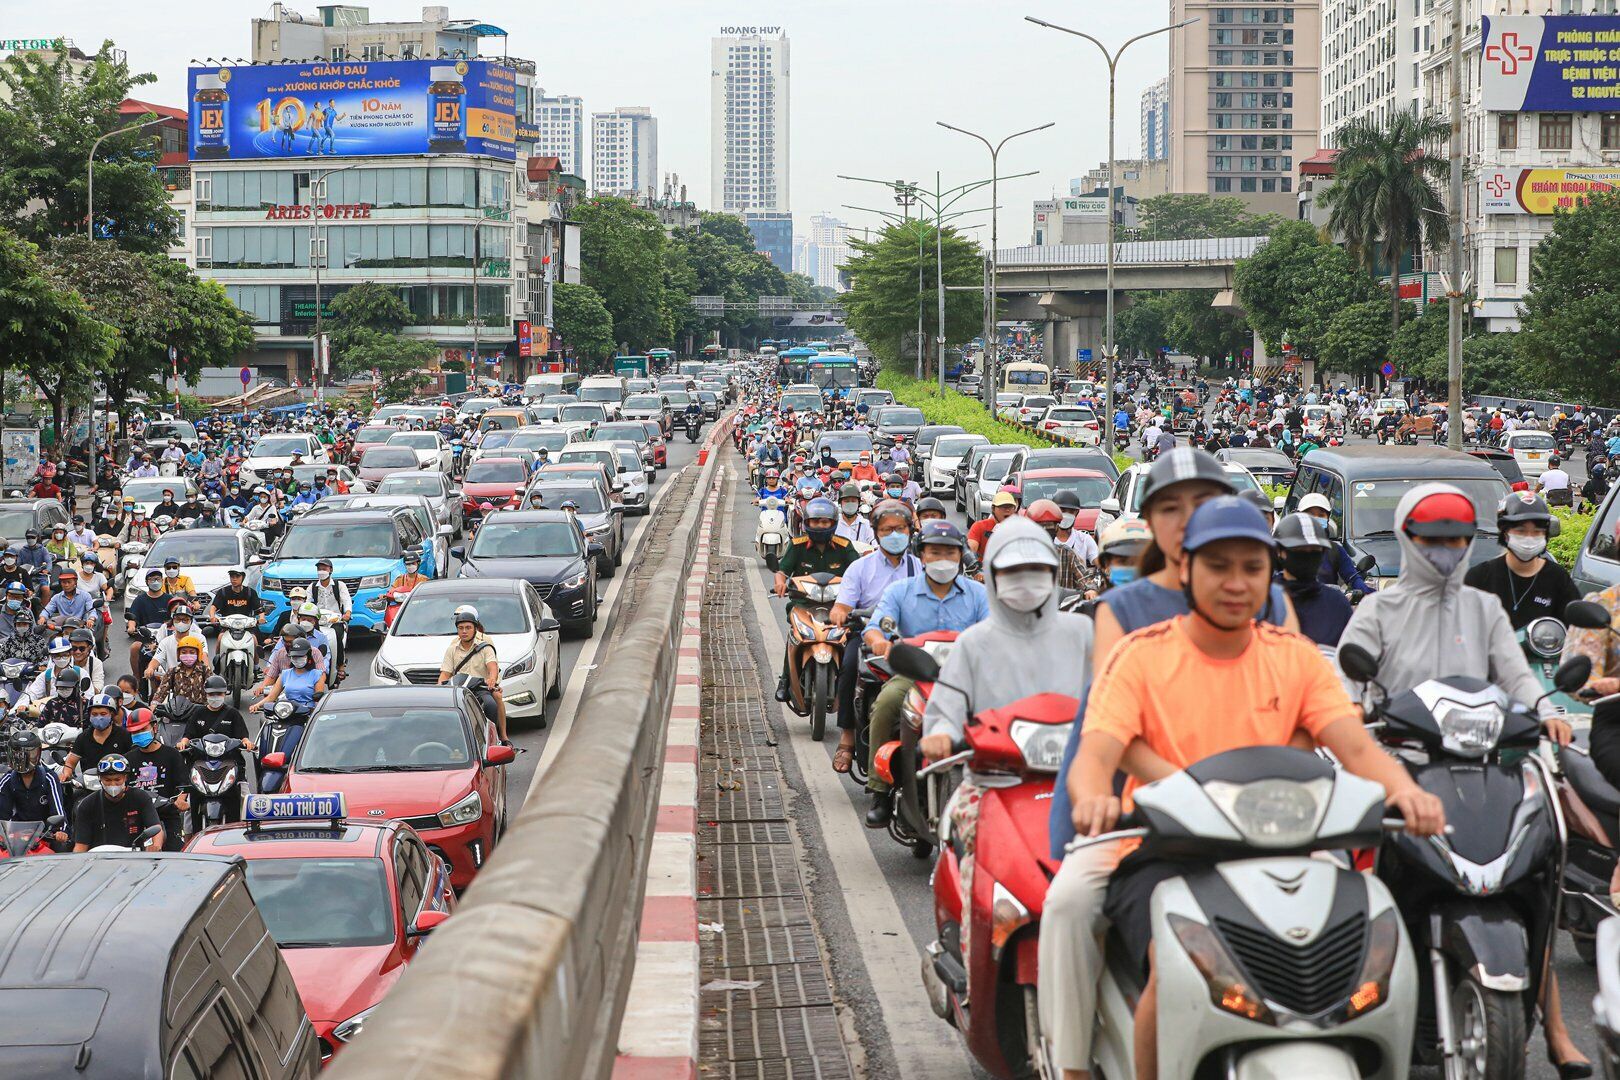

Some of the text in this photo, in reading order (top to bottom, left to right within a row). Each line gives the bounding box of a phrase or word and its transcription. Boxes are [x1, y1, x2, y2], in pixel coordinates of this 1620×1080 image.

[720, 26, 781, 34] HOANG HUY
[1557, 29, 1592, 43] PHÒNG
[1544, 48, 1571, 64] TRỰC
[1573, 47, 1606, 64] THUỘC
[312, 62, 340, 76] GIẢM
[343, 65, 368, 75] ĐAU
[1562, 66, 1590, 82] BỆNH
[1592, 66, 1616, 82] VIỆN
[285, 82, 318, 92] XƯƠNG
[320, 80, 346, 91] KHỚP
[347, 78, 373, 89] CHẮC
[374, 76, 400, 88] KHỎE
[1572, 86, 1586, 98] 52
[362, 98, 402, 112] 10 NĂM
[434, 102, 460, 122] JEX
[200, 109, 224, 129] JEX
[1531, 181, 1559, 193] KHÁM
[266, 204, 371, 220] ARIES COFFEE
[273, 798, 332, 816] SAO THỦ ĐÔ
